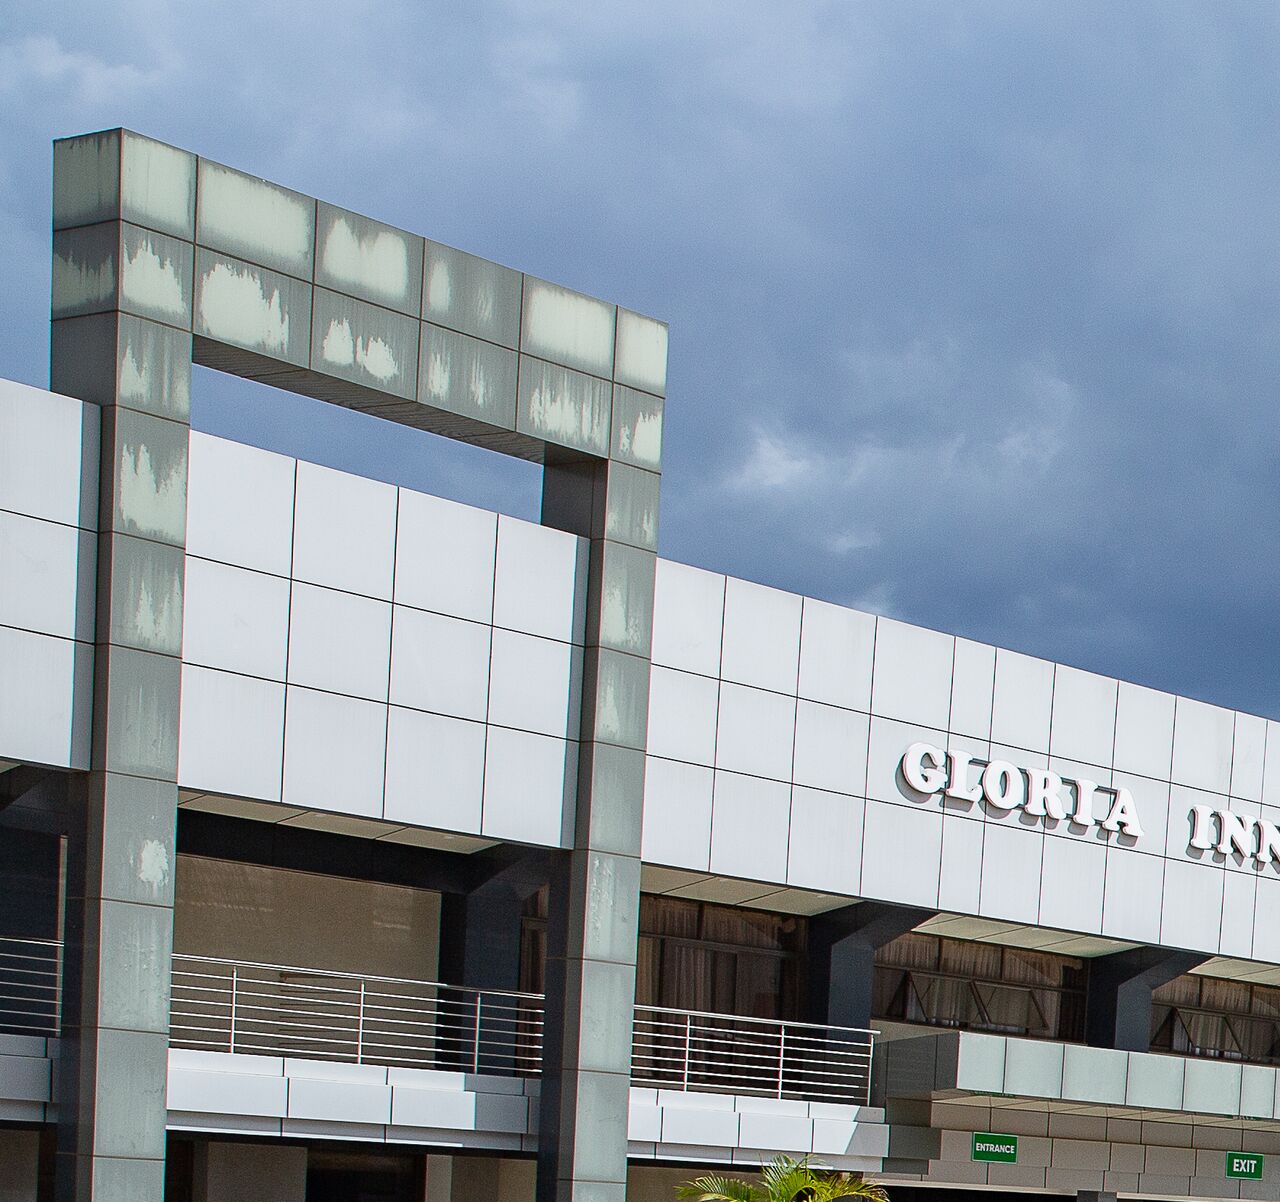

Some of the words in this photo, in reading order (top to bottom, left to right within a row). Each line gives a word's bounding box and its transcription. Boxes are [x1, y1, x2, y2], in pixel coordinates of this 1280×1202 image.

[902, 742, 1145, 837] GLORIA
[975, 1142, 1016, 1154] ENTRANCE
[1232, 1158, 1257, 1173] EXIT
